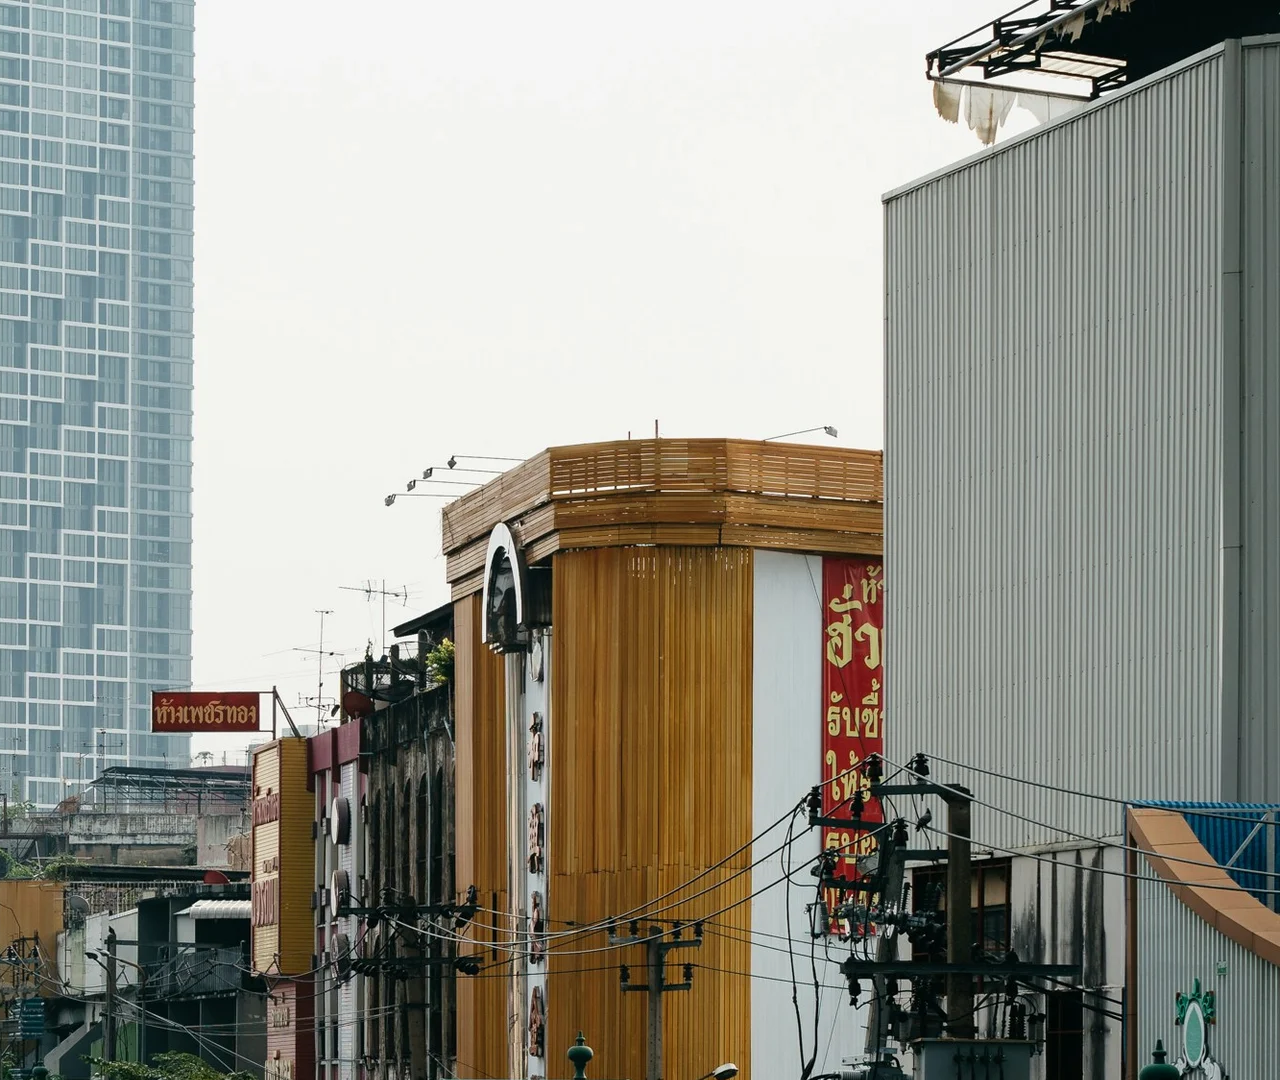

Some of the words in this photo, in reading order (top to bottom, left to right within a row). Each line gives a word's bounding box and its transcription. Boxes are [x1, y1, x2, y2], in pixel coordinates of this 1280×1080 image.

[827, 584, 883, 669] ฮั่ว
[155, 698, 256, 724] ห้างเพชรทอง
[827, 680, 883, 738] รับซื้
